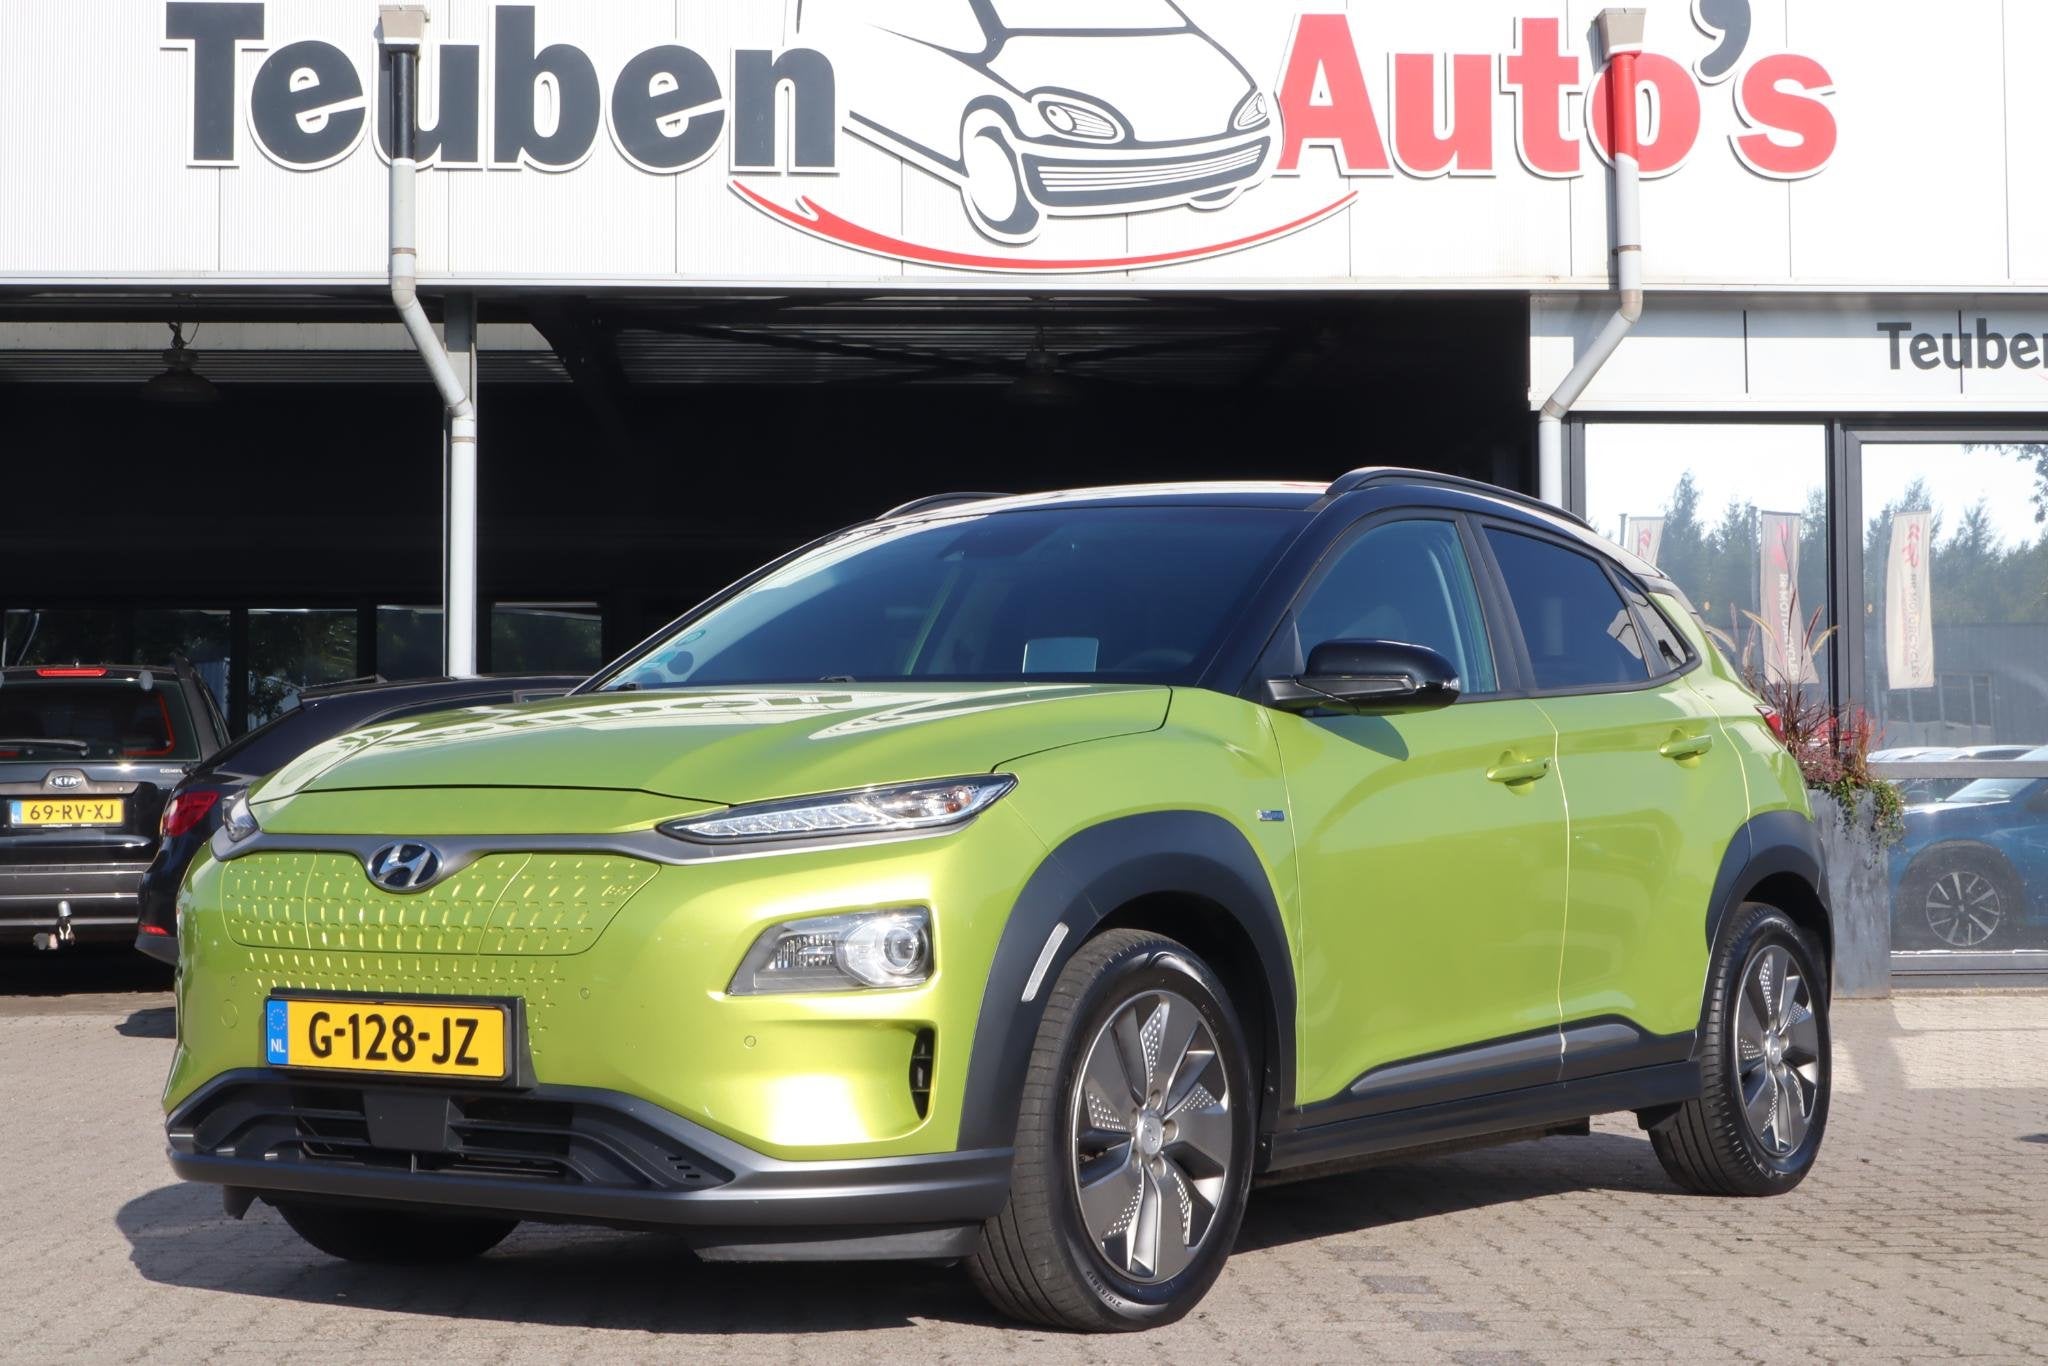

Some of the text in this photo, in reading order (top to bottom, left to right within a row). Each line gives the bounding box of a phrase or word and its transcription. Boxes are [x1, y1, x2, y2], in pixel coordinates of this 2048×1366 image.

[163, 0, 1838, 174] Teuben Auto's
[1876, 317, 2048, 370] Teube
[54, 776, 80, 786] KIA
[29, 804, 115, 820] 69-RV-XJ
[270, 1038, 286, 1054] NL
[308, 1011, 479, 1067] G-128-JZ
